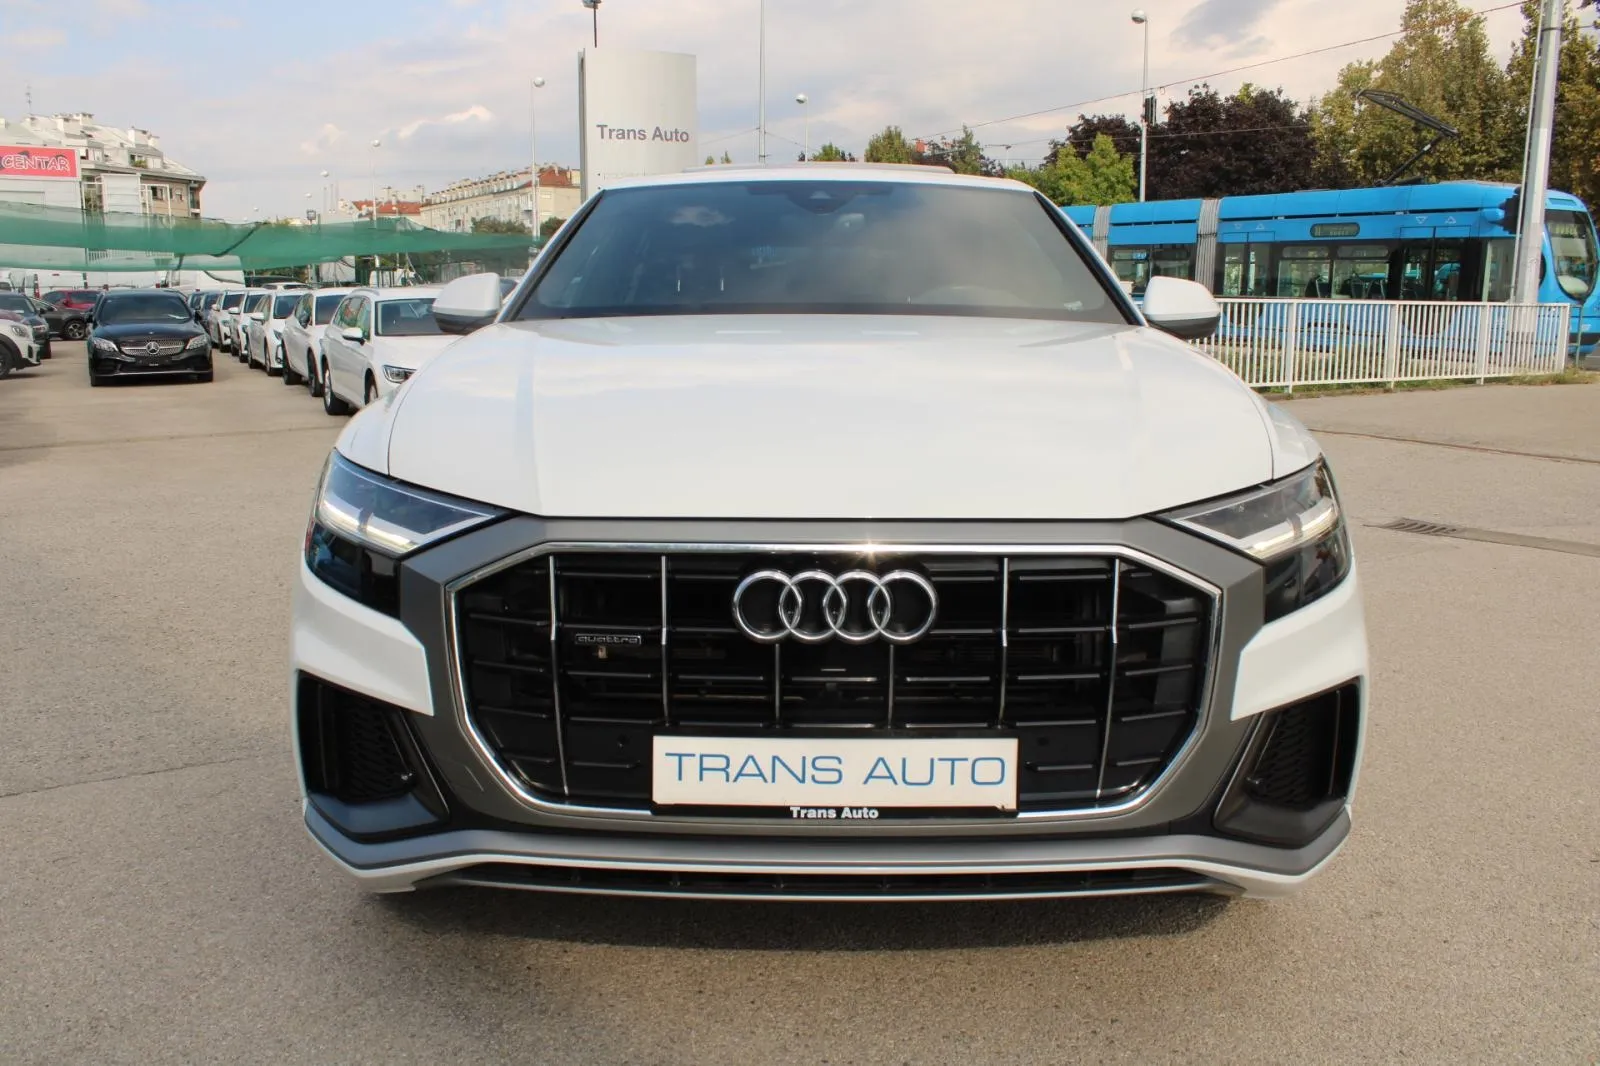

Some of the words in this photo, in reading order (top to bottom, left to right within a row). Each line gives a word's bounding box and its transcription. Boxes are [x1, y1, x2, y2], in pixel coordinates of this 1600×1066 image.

[596, 124, 647, 141] Trans
[652, 126, 690, 143] Auto
[1, 154, 70, 171] CENTAR
[577, 636, 638, 644] quattro
[665, 752, 844, 785] TRANS
[863, 757, 1006, 786] AUTO
[789, 806, 837, 819] Trans
[841, 807, 879, 819] Auto
